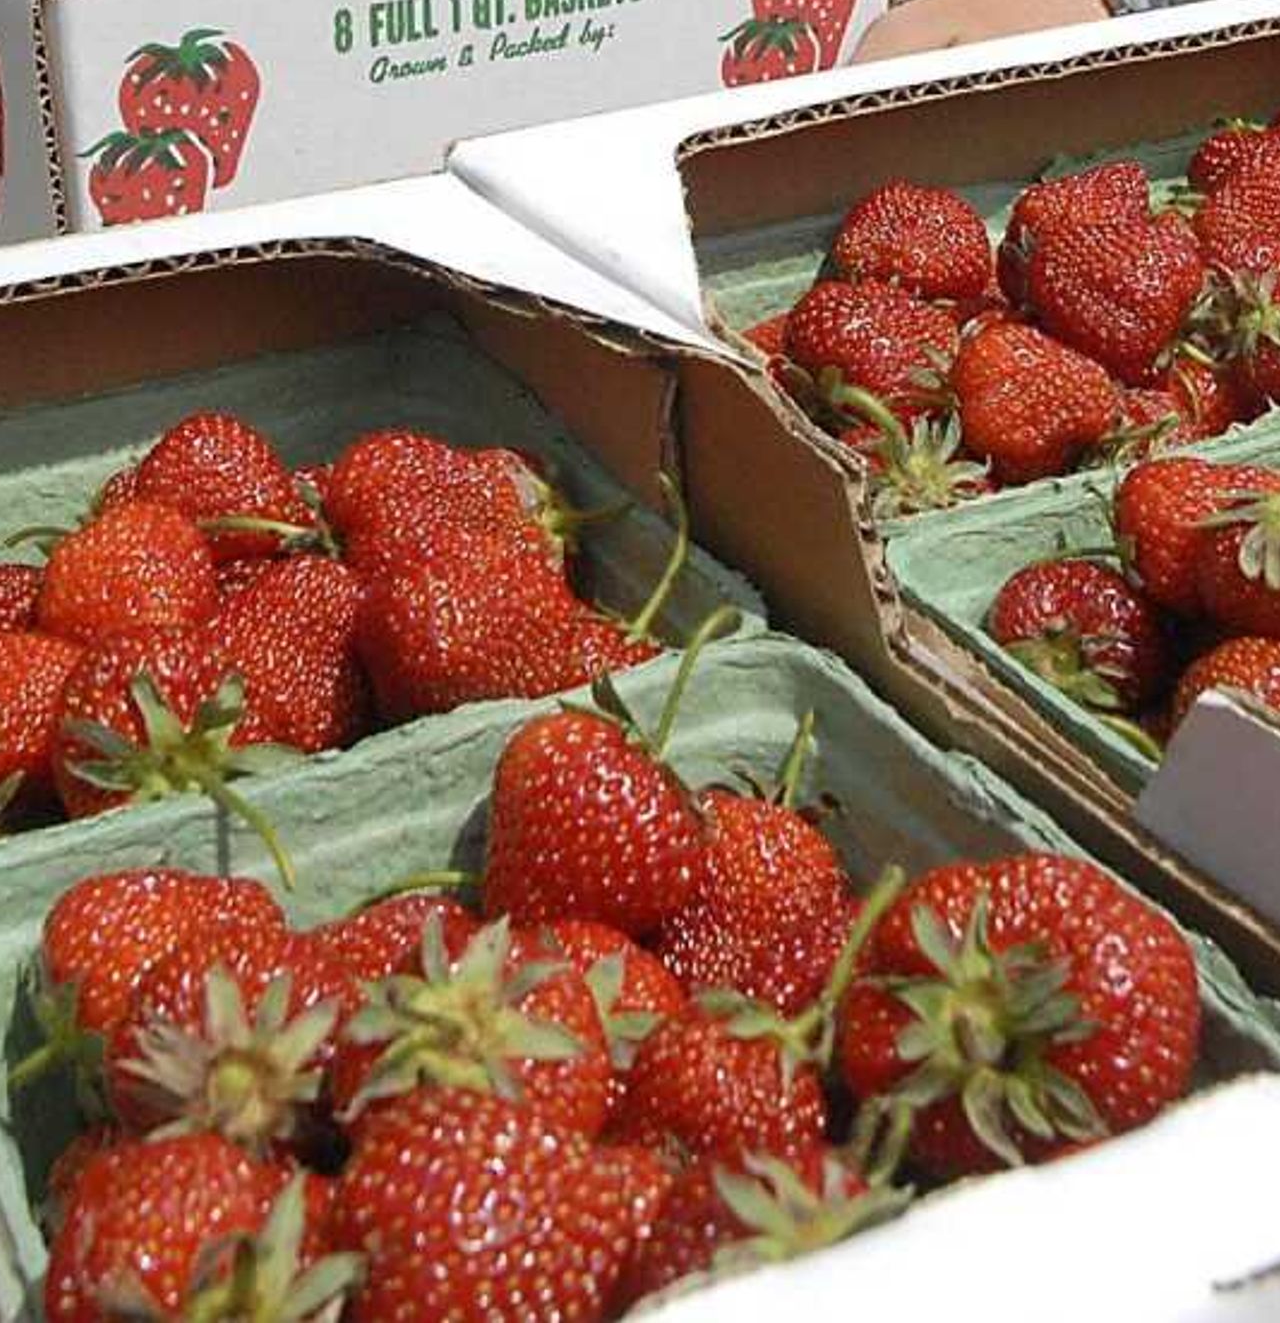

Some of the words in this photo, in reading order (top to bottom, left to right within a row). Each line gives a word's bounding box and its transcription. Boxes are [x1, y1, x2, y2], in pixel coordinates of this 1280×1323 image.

[333, 7, 354, 55] 8
[370, 55, 447, 83] Grown
[458, 44, 475, 67] &
[489, 22, 570, 62] Packed
[579, 18, 615, 53] by:
